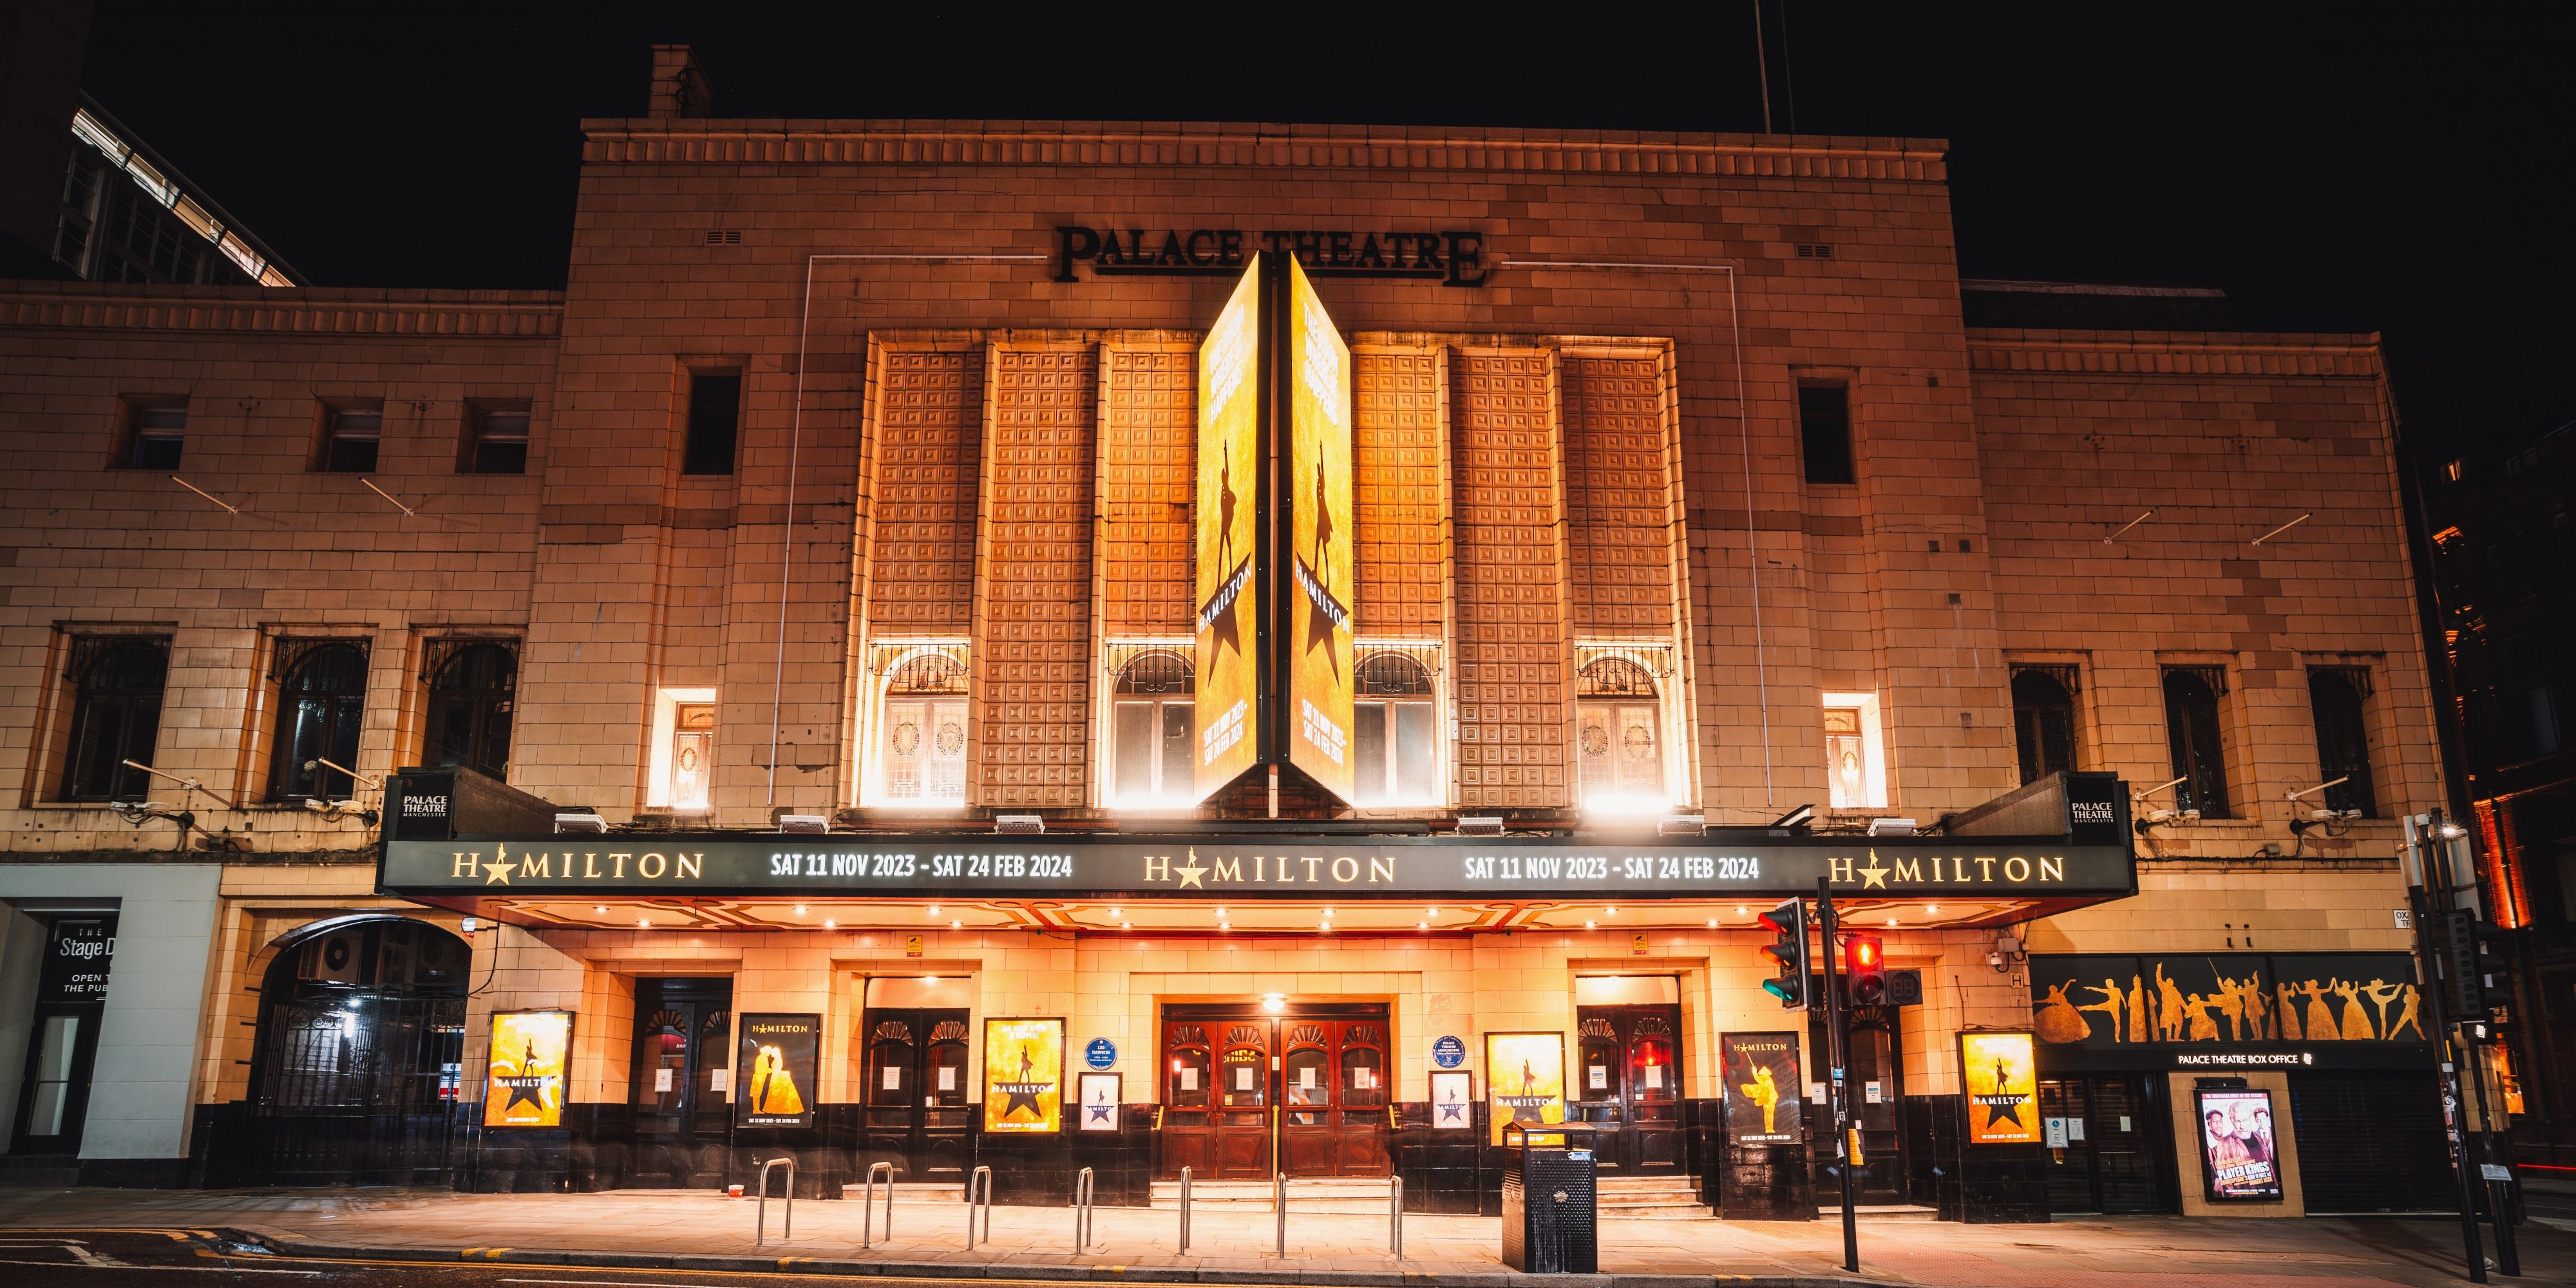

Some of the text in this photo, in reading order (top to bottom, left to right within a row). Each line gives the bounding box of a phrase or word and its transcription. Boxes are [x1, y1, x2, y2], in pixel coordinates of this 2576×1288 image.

[1054, 226, 1487, 287] PALACE THEATRE
[1198, 561, 1252, 634] HAMILTON
[1296, 560, 1350, 634] HAMILTON
[1302, 699, 1312, 721] SAT
[1312, 708, 1320, 728] 11
[1204, 726, 1213, 747] SAT
[1213, 721, 1220, 740] 11
[1220, 710, 1231, 734] NOV
[1204, 721, 1244, 766] SAT 24 FEB 2024
[1303, 720, 1343, 766] SAT 24 FEB 2024
[403, 795, 448, 804] PALACE
[771, 854, 802, 875] SAT
[806, 854, 828, 876] 11
[833, 855, 869, 876] NOV
[872, 855, 915, 876] 2023
[933, 855, 963, 876] SAT
[968, 855, 989, 876] 24
[995, 855, 1025, 876] FEB
[1030, 855, 1072, 877] 2024
[1465, 857, 1495, 879] SAT
[1500, 857, 1522, 879] 11
[1526, 857, 1561, 879] NOV
[1566, 857, 1607, 879] 2023
[1624, 857, 1654, 878] SAT
[1659, 857, 1680, 878] 24
[1685, 857, 1714, 878] FEB
[1719, 857, 1759, 879] 2024
[60, 938, 103, 960] Stage
[2012, 974, 2022, 986] H
[2178, 1054, 2298, 1064] PALACE THEATRE BOX OFFICE
[495, 1078, 551, 1087] HAMILT
[992, 1084, 1055, 1093] HAMILTON
[1972, 1097, 2032, 1105] HAMILTON
[2217, 1166, 2246, 1180] PLAYER
[2244, 1161, 2270, 1175] KINGS
